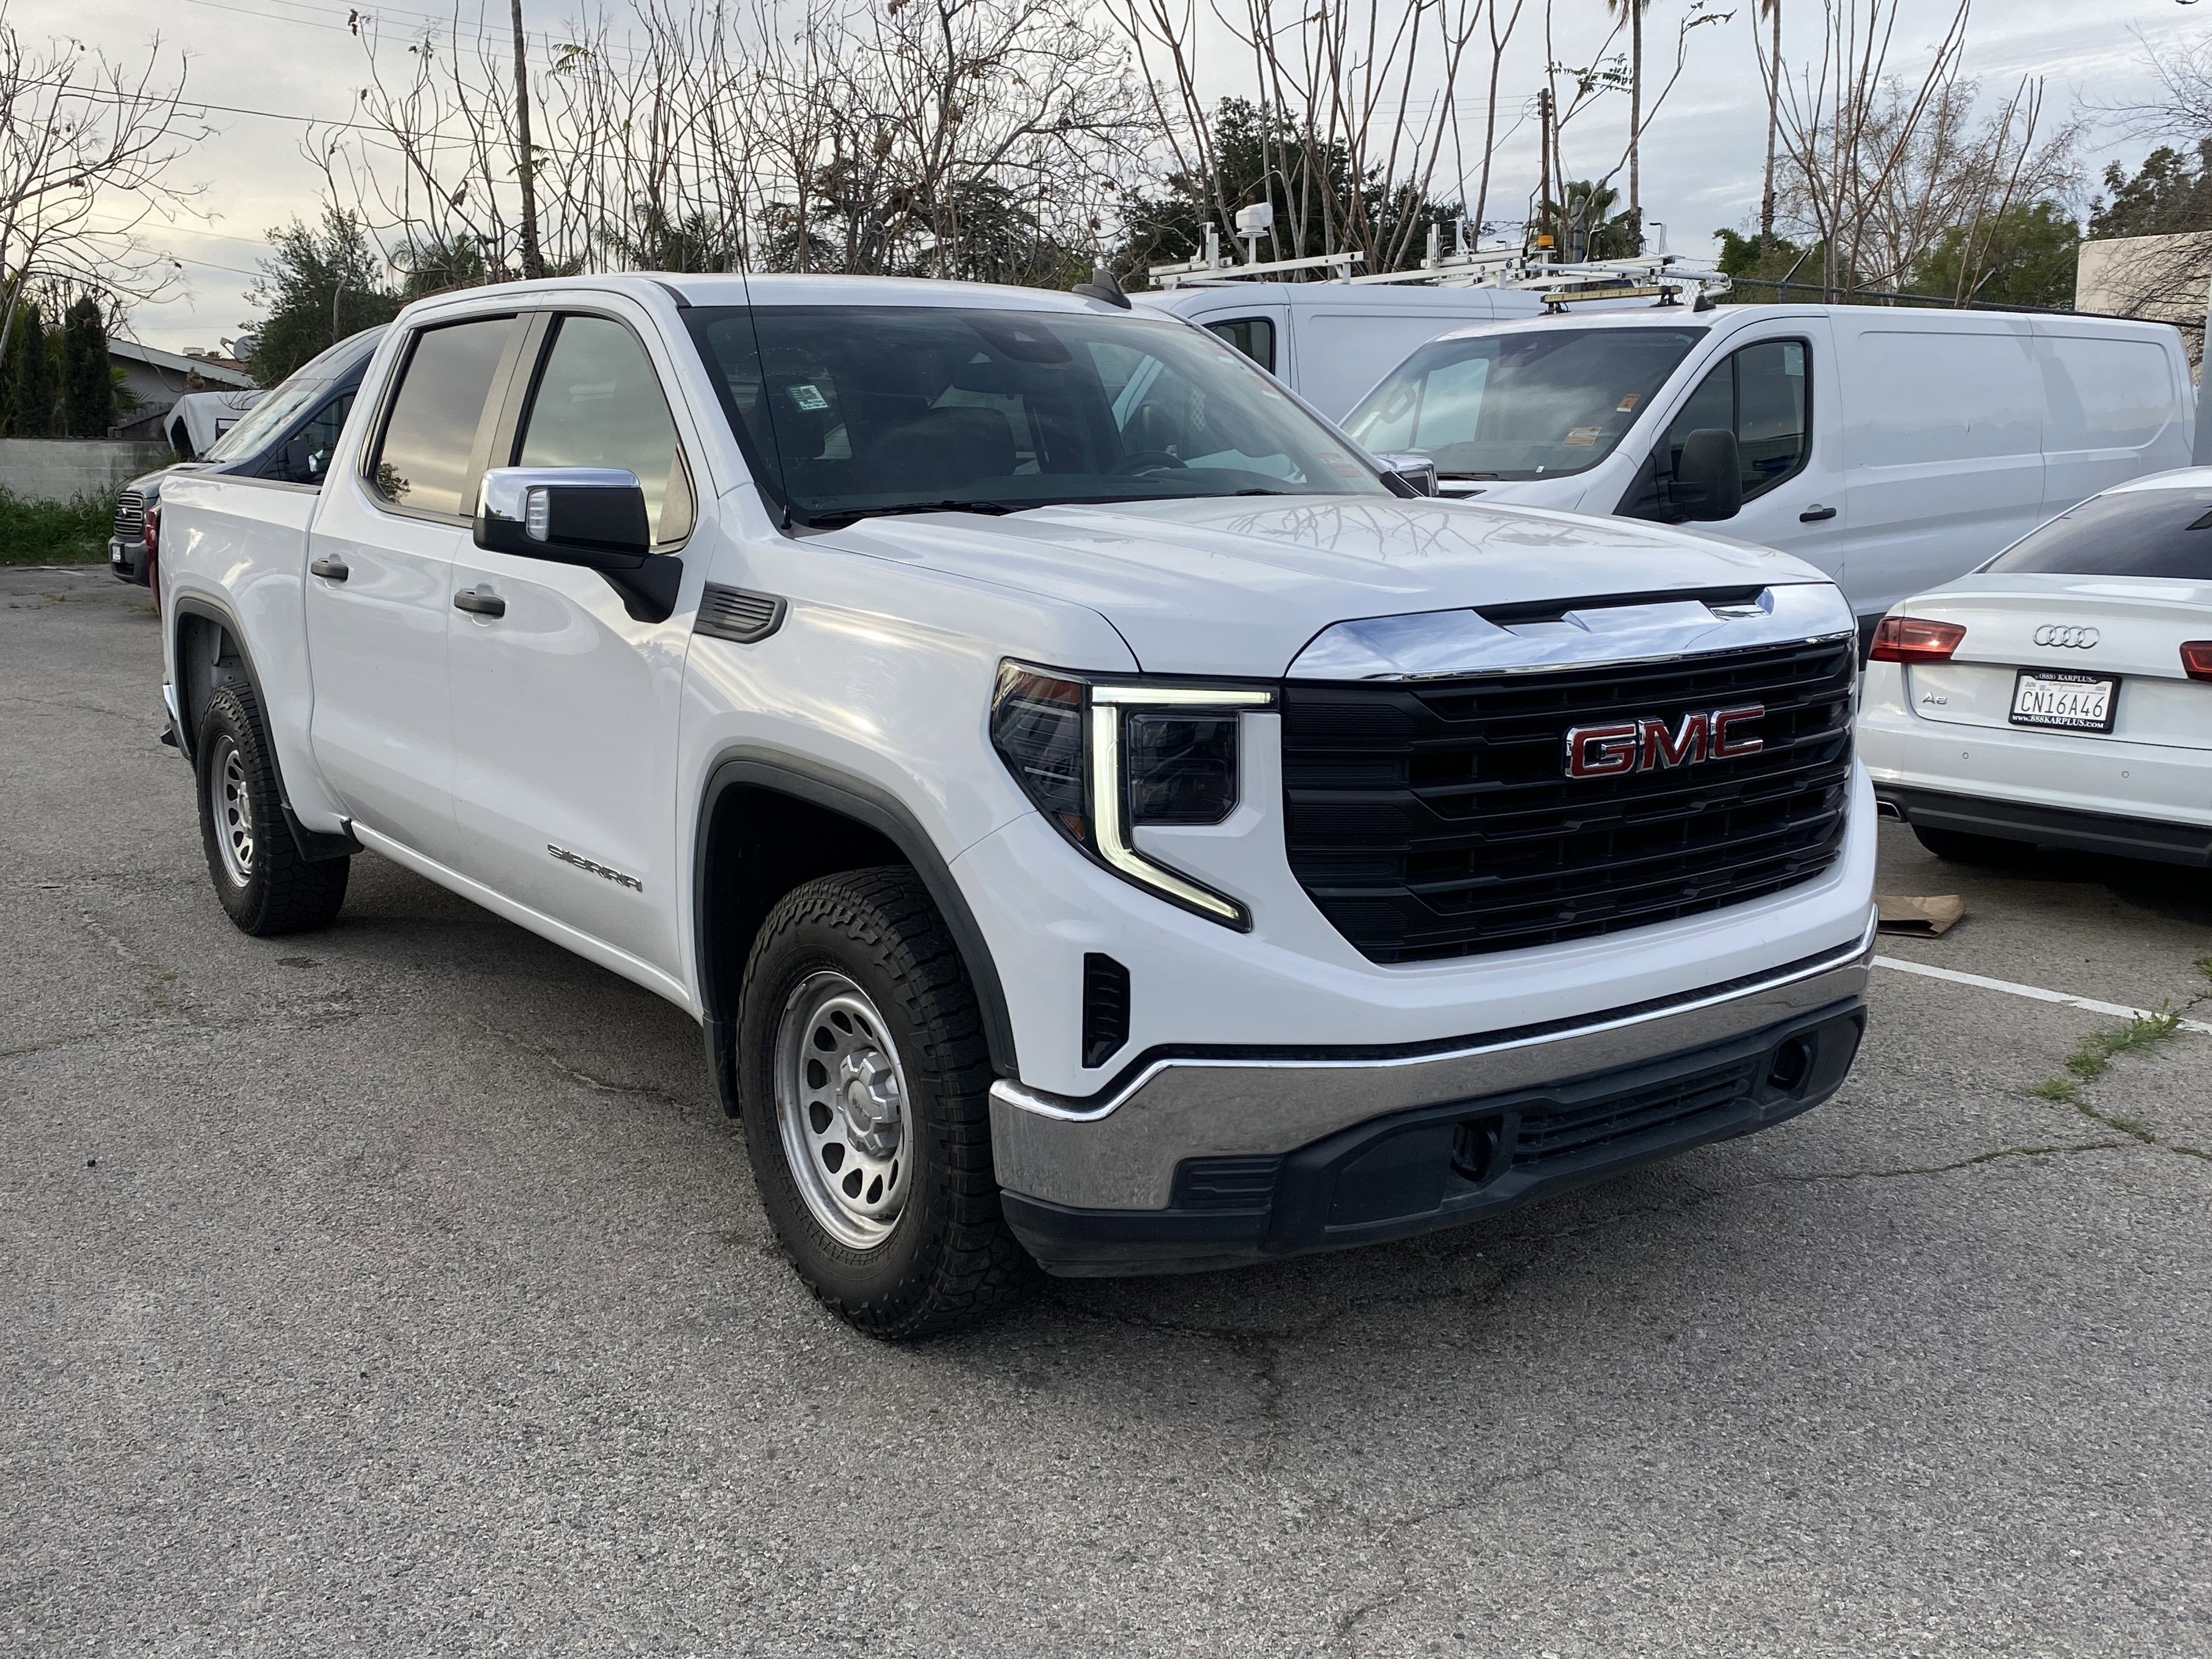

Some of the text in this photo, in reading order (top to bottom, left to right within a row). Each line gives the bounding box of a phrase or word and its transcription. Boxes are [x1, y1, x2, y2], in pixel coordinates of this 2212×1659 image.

[2058, 674, 2092, 683] KARPLUS
[2021, 691, 2106, 718] CN16A46
[1565, 704, 1765, 779] GMC
[547, 843, 642, 892] SIERRA
